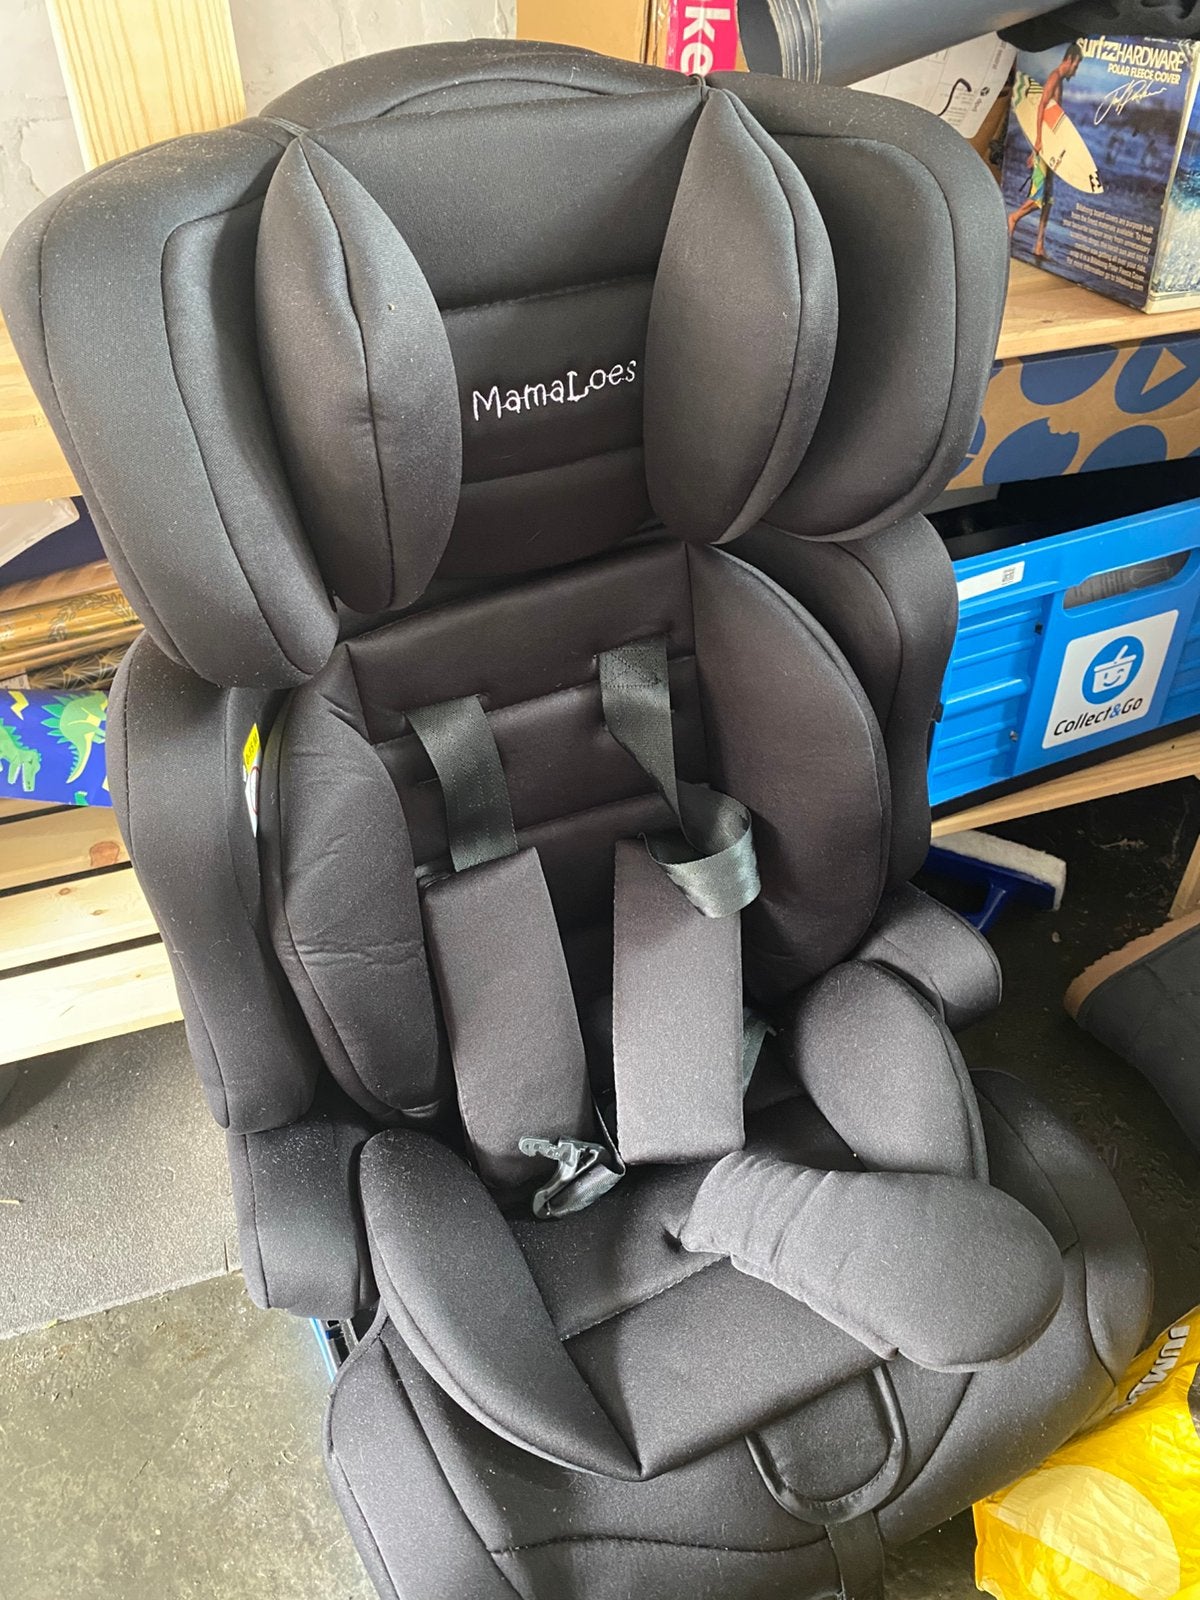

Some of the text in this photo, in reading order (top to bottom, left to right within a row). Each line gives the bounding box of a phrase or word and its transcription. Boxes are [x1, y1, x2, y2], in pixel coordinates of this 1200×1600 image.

[680, 0, 731, 77] ke
[1108, 63, 1181, 85] POLAR FLEECE COVER
[1117, 44, 1184, 72] HARDWARE
[472, 360, 637, 421] MamaLoes
[1053, 698, 1143, 736] Collect&Go
